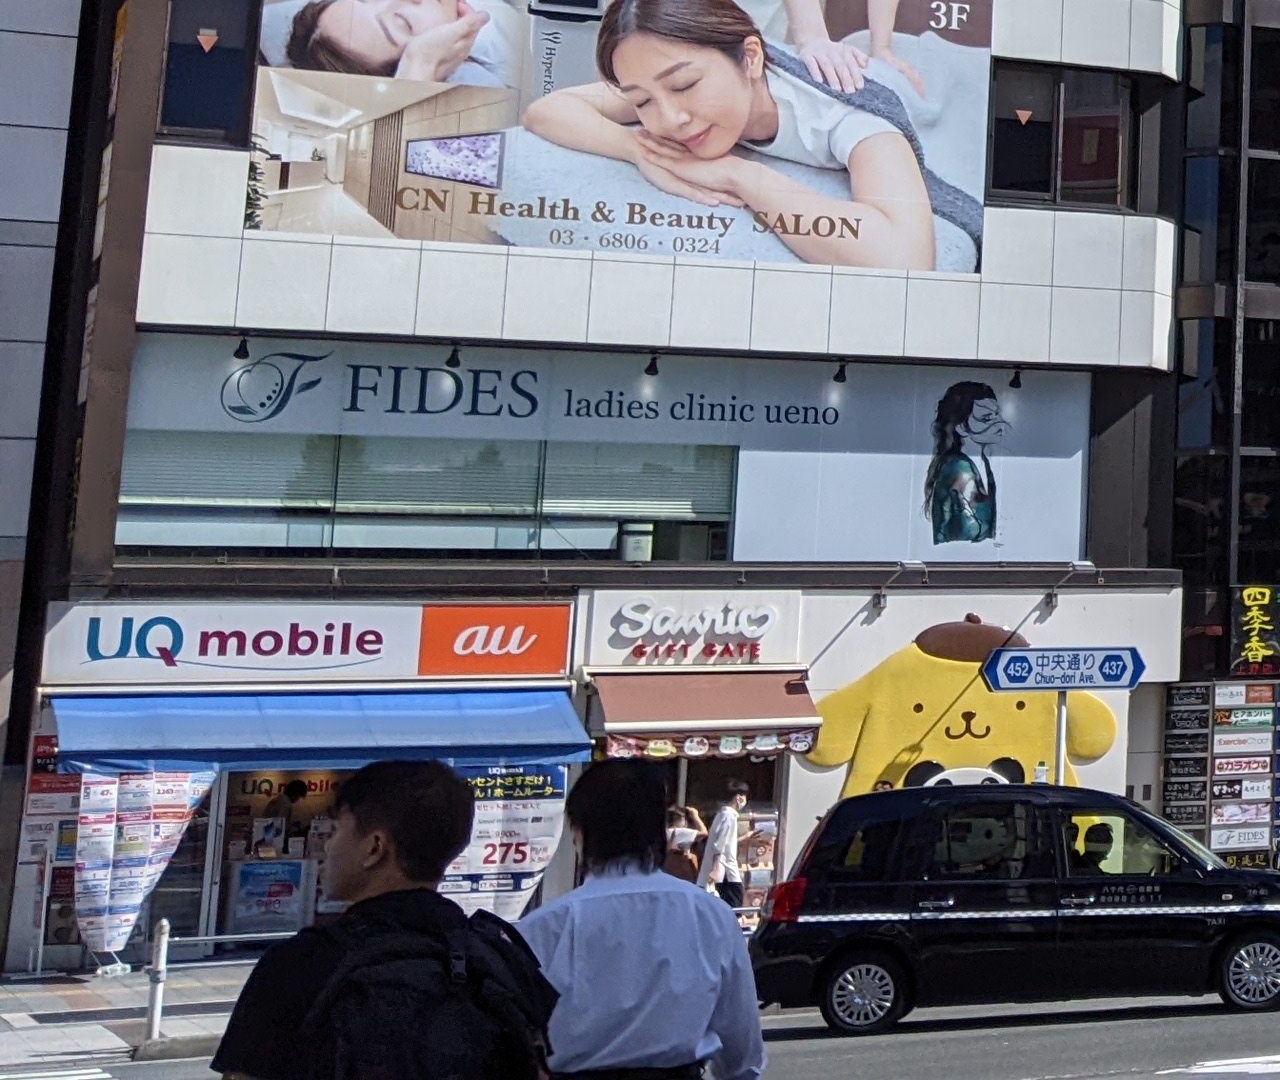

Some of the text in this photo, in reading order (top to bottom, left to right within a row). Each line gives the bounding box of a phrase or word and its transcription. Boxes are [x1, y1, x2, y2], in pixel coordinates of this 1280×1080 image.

[928, 1, 972, 31] 3F
[394, 186, 863, 241] CN Health & Beauty SALON
[345, 364, 839, 427] FIDES ladies clinic ueno
[617, 597, 776, 640] Sanrio
[1242, 587, 1274, 663] 四季香
[86, 615, 383, 667] UQ mobile
[453, 625, 537, 656] au
[631, 640, 761, 660] GIFT GATE
[1007, 662, 1030, 677] 452
[1036, 653, 1095, 671] 中央通り
[1102, 661, 1124, 676] 437
[1035, 672, 1097, 685] Chuo-dori Ave.
[1224, 760, 1262, 770] カラオケ
[242, 778, 272, 796] UQ
[1237, 830, 1265, 842] FIDES
[482, 842, 528, 864] 275
